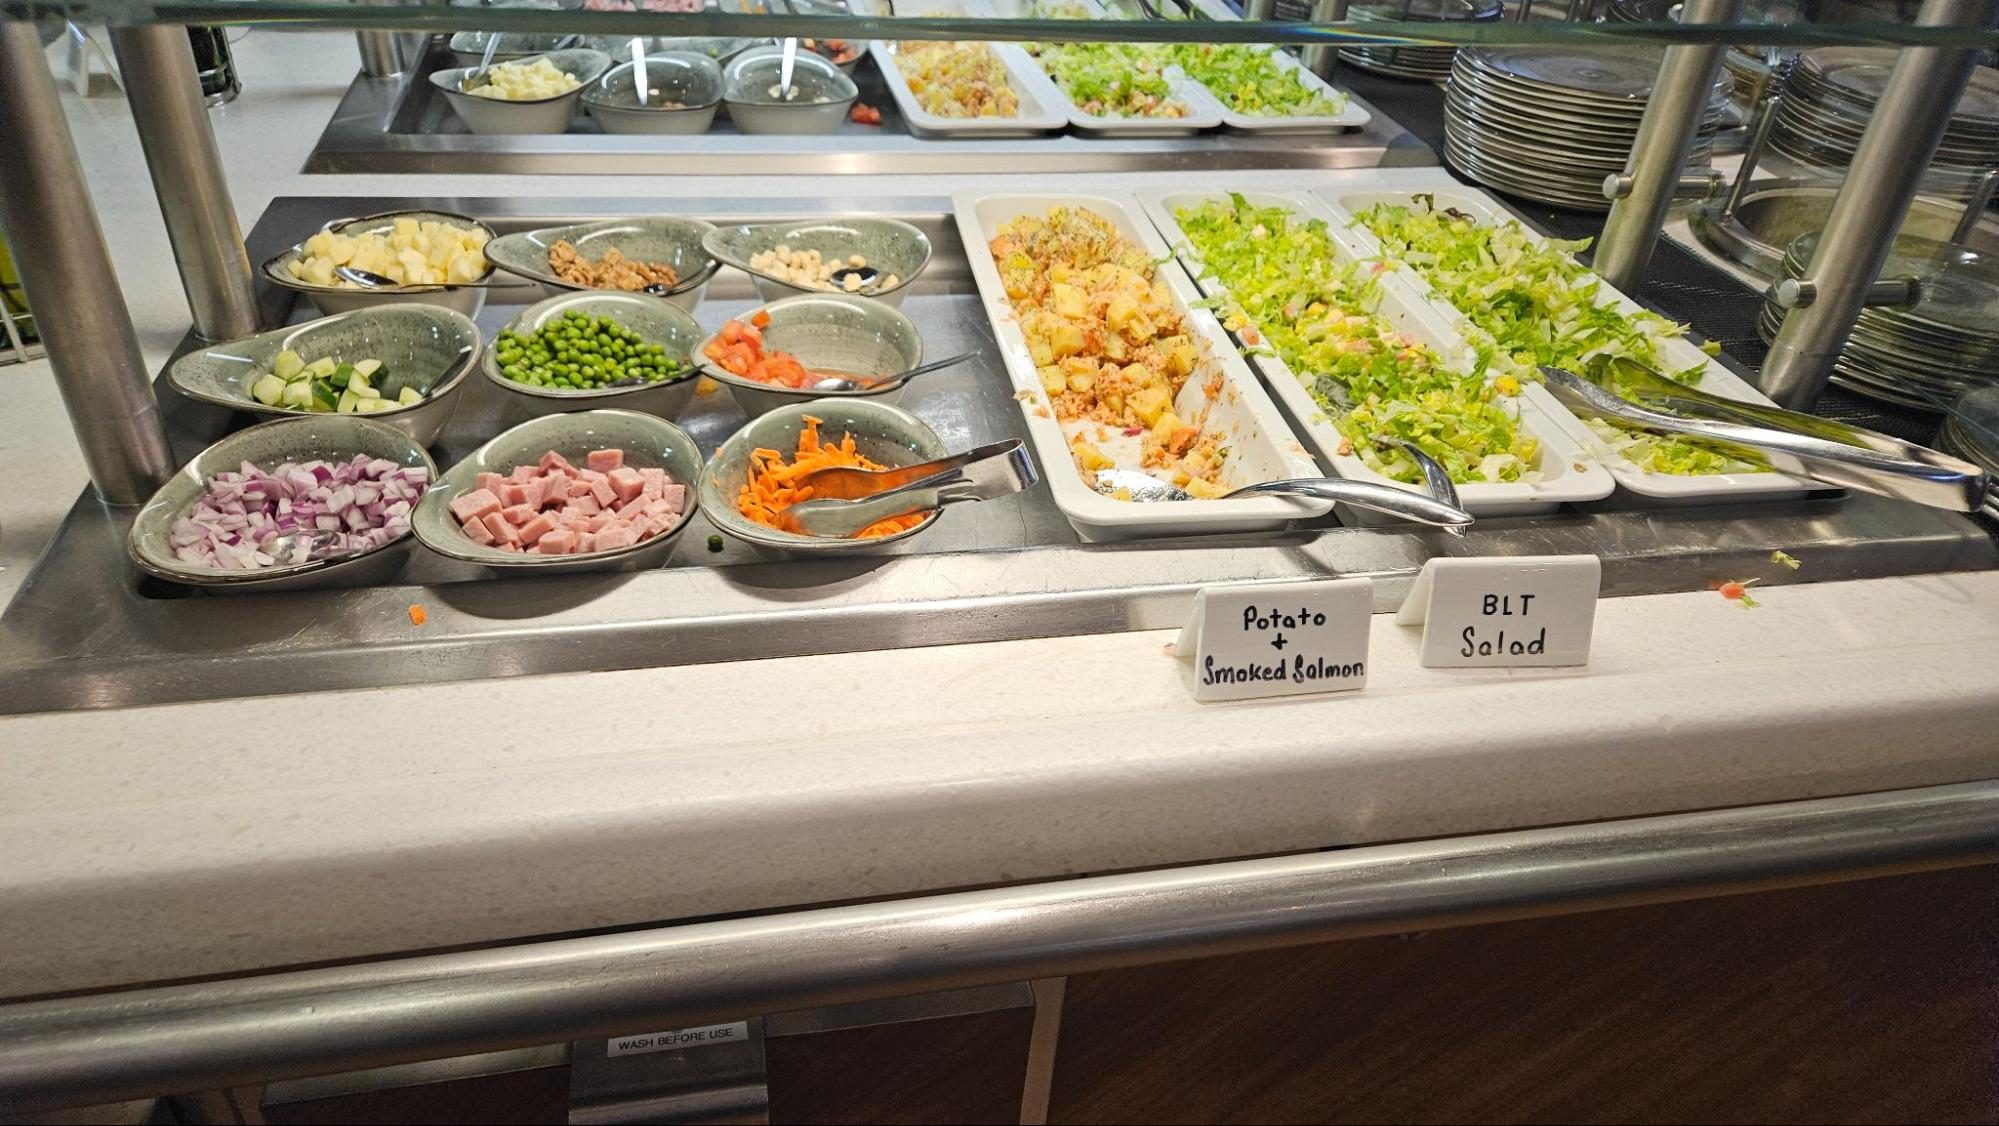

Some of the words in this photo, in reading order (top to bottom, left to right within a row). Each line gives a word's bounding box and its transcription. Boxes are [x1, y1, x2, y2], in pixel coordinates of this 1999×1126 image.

[1243, 605, 1327, 631] Potato
[1482, 594, 1536, 617] BLT
[1270, 633, 1288, 650] +
[1461, 627, 1545, 659] Salad
[1203, 655, 1286, 685] Smoked
[1292, 654, 1365, 684] Salmon
[618, 1039, 654, 1051] WASH
[658, 1031, 706, 1046] BEFORE
[709, 1027, 733, 1038] USE
